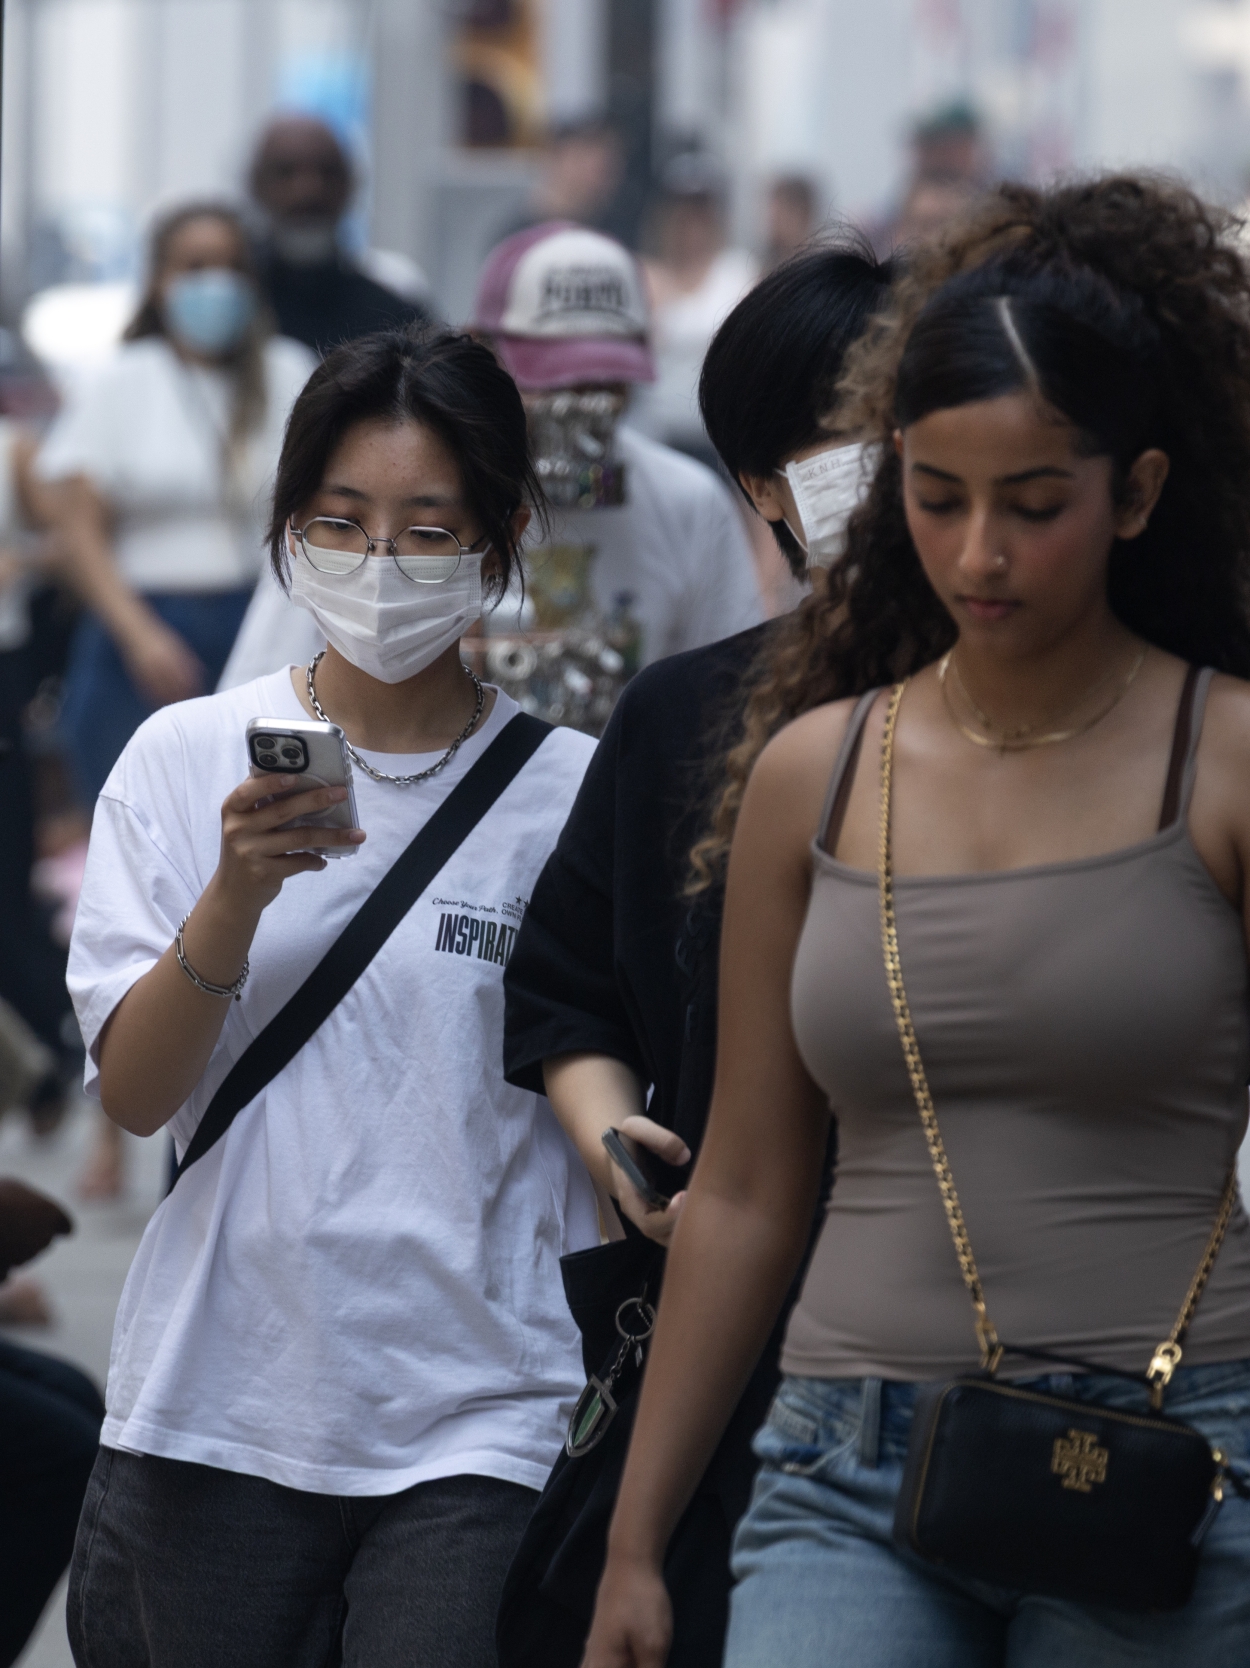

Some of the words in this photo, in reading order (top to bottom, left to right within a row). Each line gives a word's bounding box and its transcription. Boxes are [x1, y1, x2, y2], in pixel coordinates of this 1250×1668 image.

[461, 900, 478, 911] Your
[502, 902, 523, 915] CREATE
[501, 909, 516, 919] OWN
